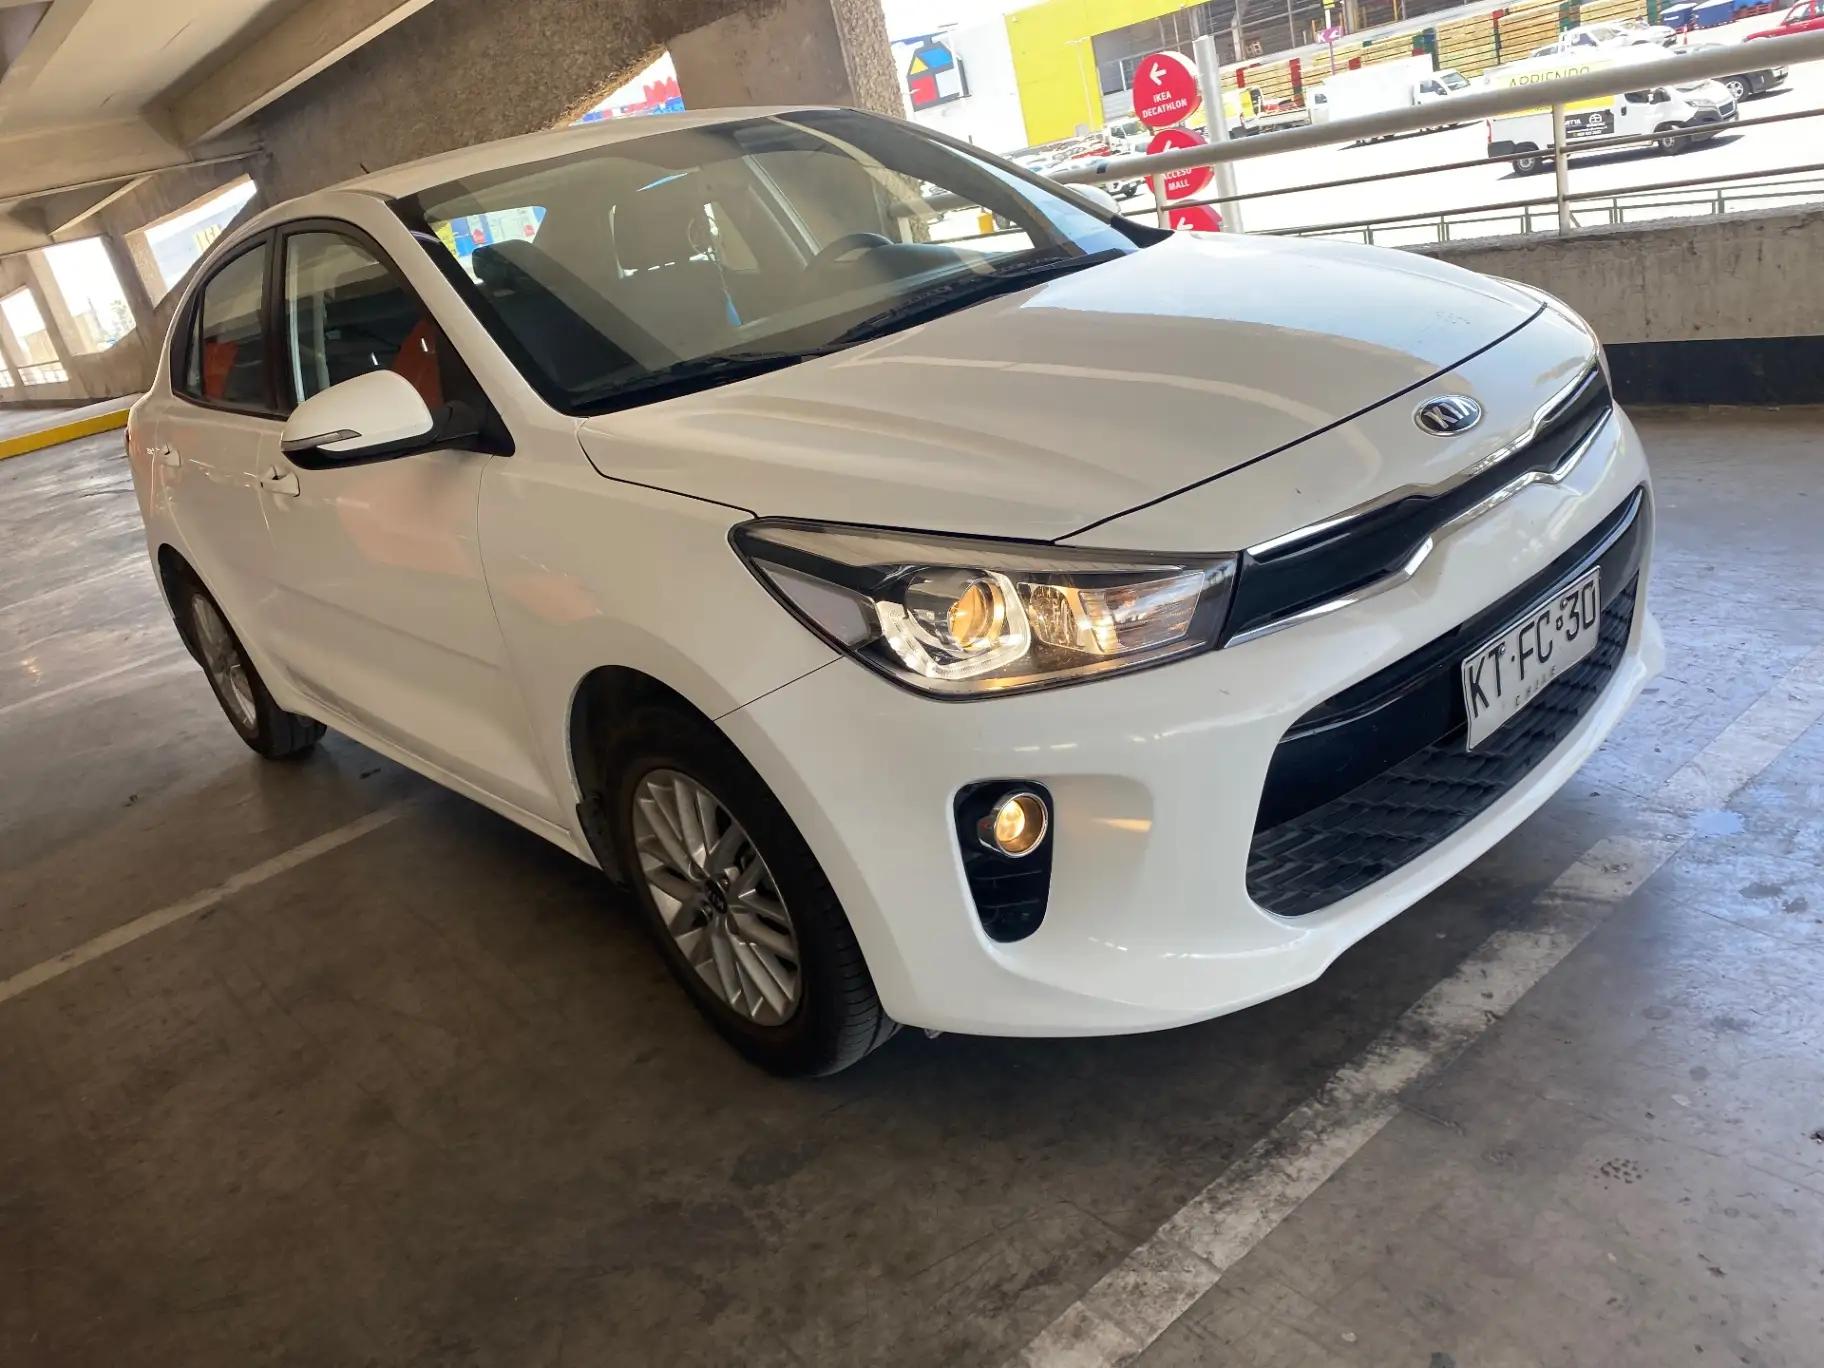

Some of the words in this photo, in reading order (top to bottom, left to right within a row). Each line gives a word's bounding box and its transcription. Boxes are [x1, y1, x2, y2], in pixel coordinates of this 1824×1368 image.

[1153, 91, 1172, 103] IKEA
[1142, 98, 1187, 118] DECATHLON
[1168, 179, 1190, 191] MALL
